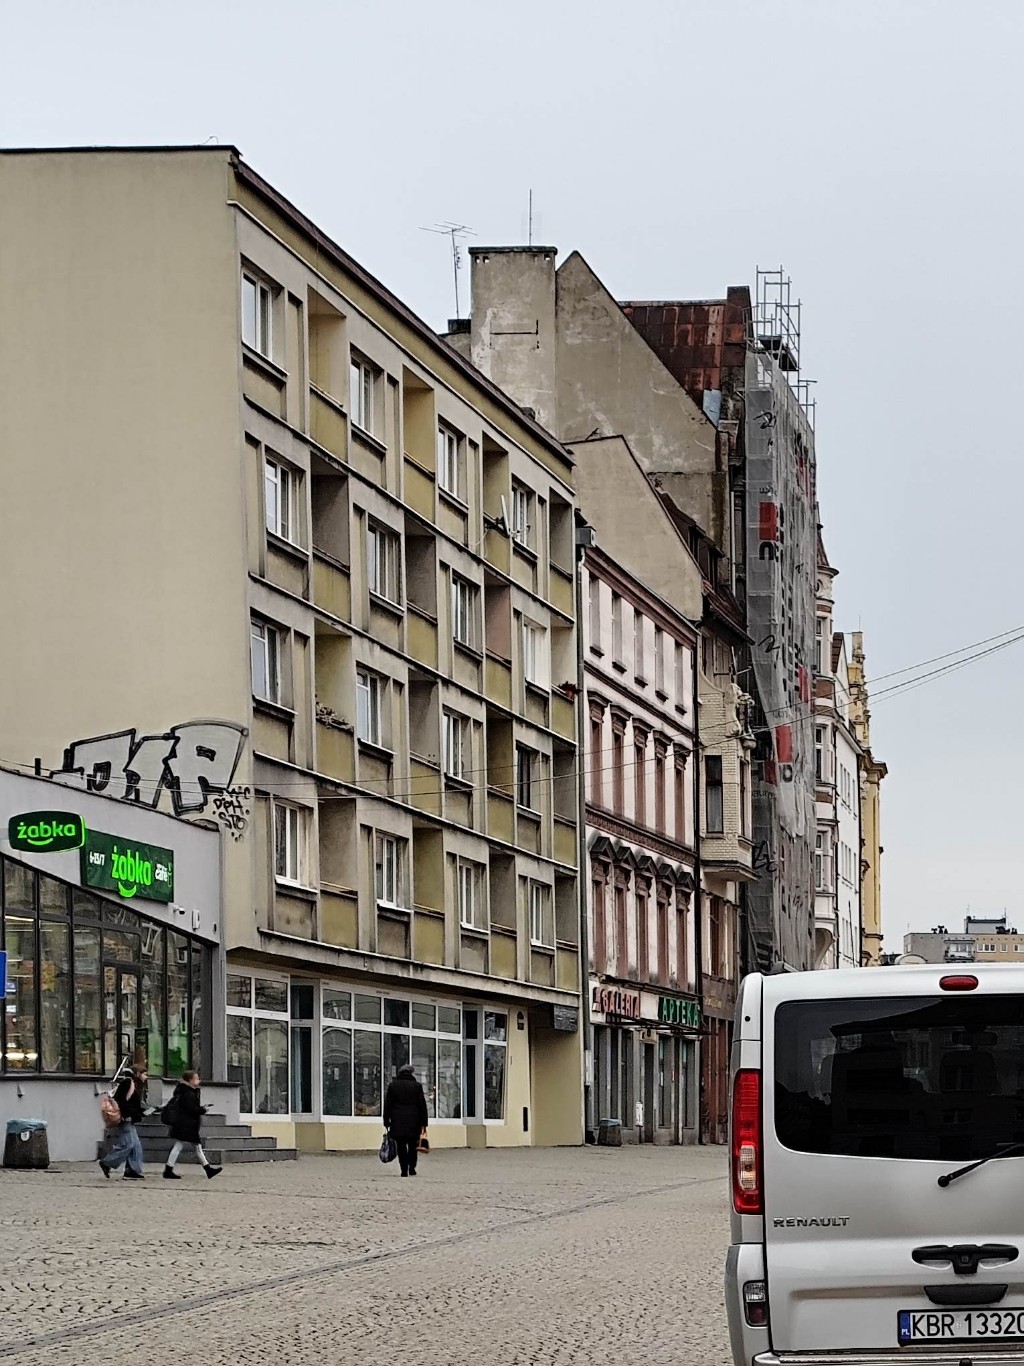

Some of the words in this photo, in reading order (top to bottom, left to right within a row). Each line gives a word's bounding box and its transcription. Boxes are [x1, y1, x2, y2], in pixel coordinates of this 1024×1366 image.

[17, 821, 76, 839] żabka
[111, 845, 152, 886] żabka
[662, 997, 701, 1028] APTEKA
[773, 1216, 850, 1228] RENAULT
[912, 1314, 955, 1337] KBR
